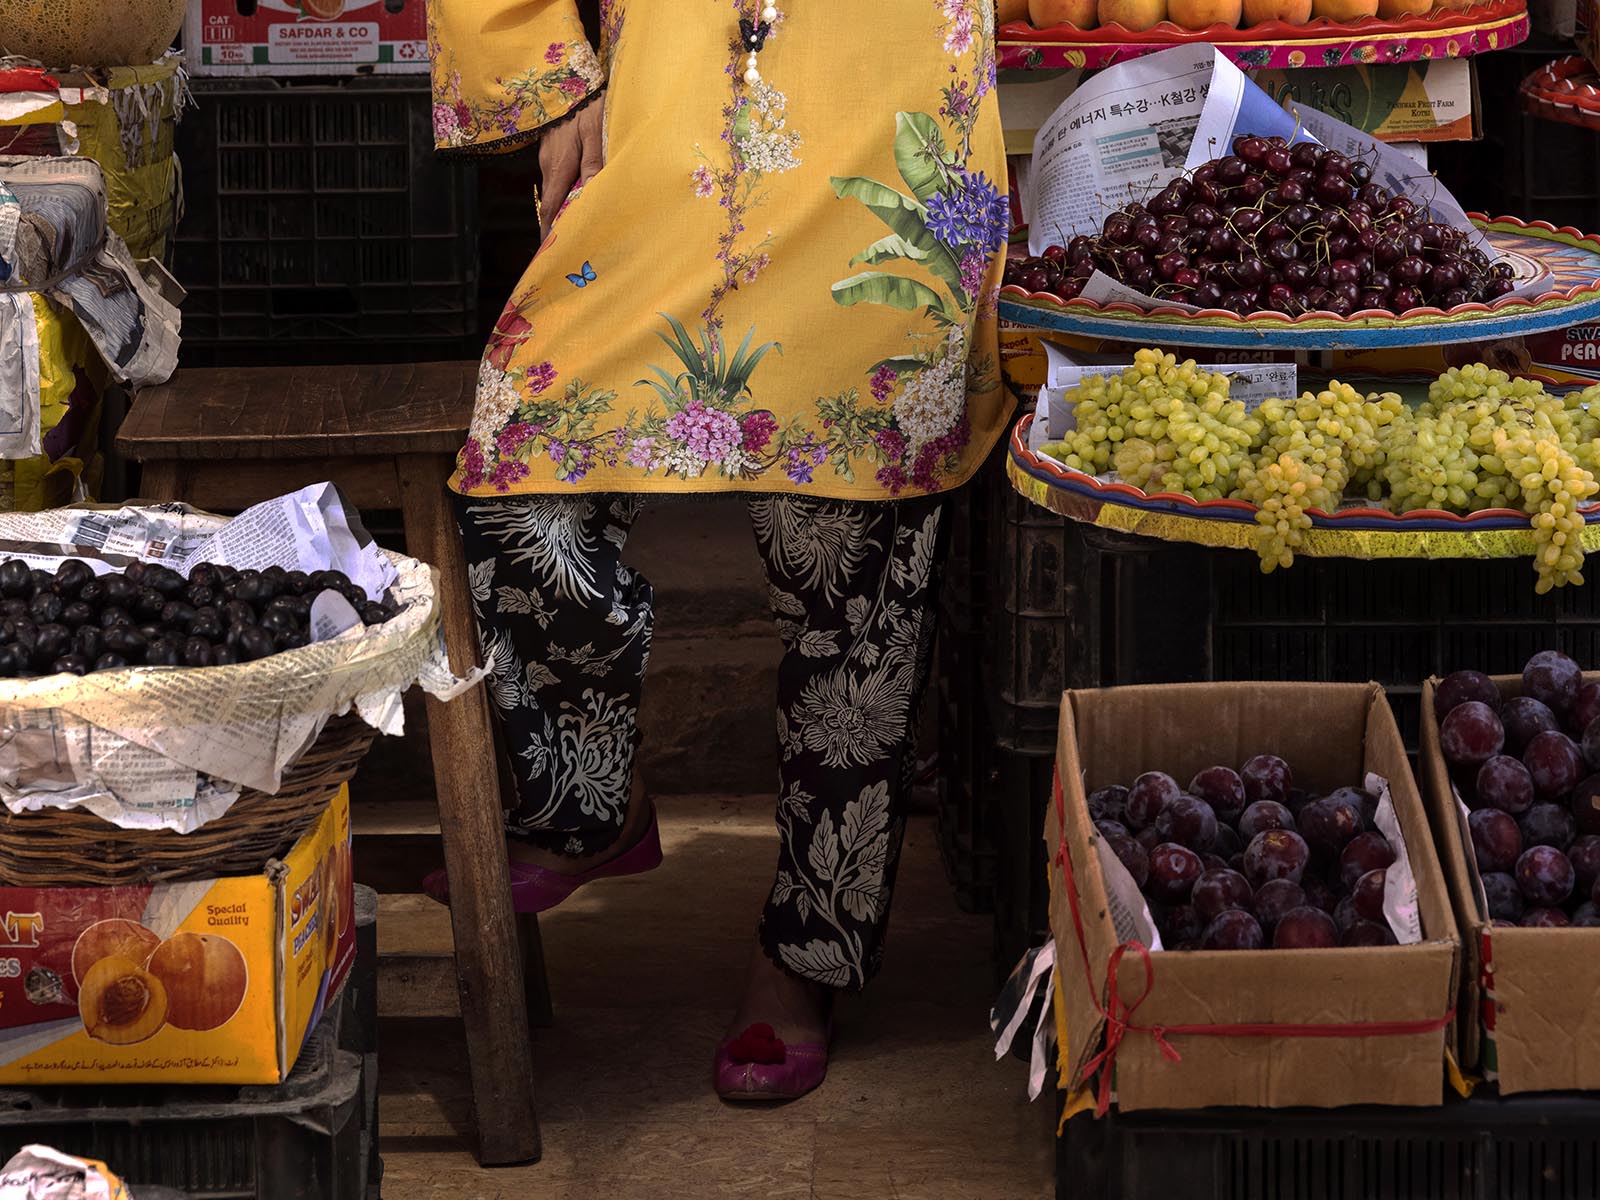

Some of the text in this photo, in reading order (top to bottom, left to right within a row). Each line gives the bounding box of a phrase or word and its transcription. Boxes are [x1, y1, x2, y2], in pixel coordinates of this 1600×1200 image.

[209, 15, 230, 25] CAT
[279, 27, 368, 39] SAFDAR & CO
[1437, 99, 1455, 108] FARM
[1070, 107, 1107, 131] 에너지
[207, 903, 247, 916] Special
[207, 915, 249, 927] Quality
